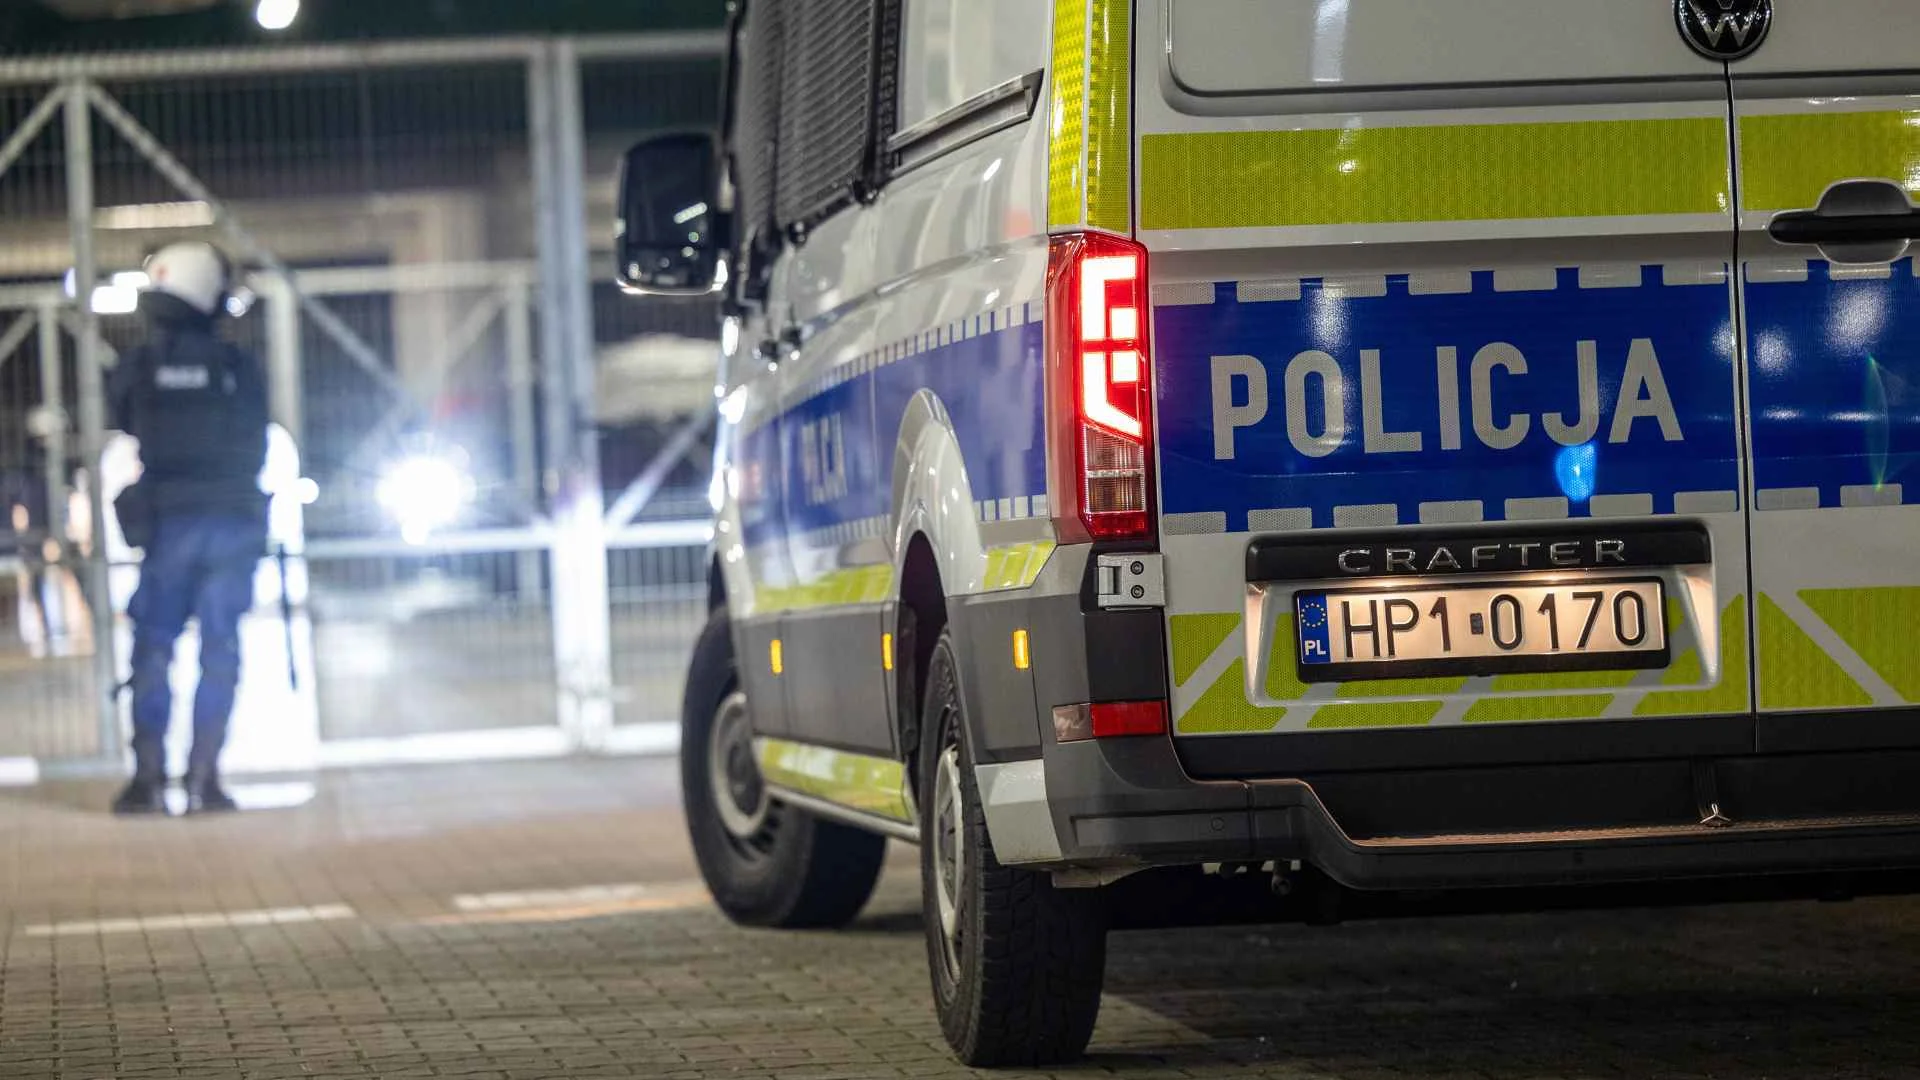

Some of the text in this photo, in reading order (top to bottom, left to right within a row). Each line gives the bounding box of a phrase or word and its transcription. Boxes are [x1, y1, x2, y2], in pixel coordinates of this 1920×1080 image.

[1210, 337, 1685, 461] POLICJA
[1338, 539, 1626, 574] CRAFTER
[1304, 639, 1327, 656] PL
[1341, 589, 1646, 659] HP1 0170
